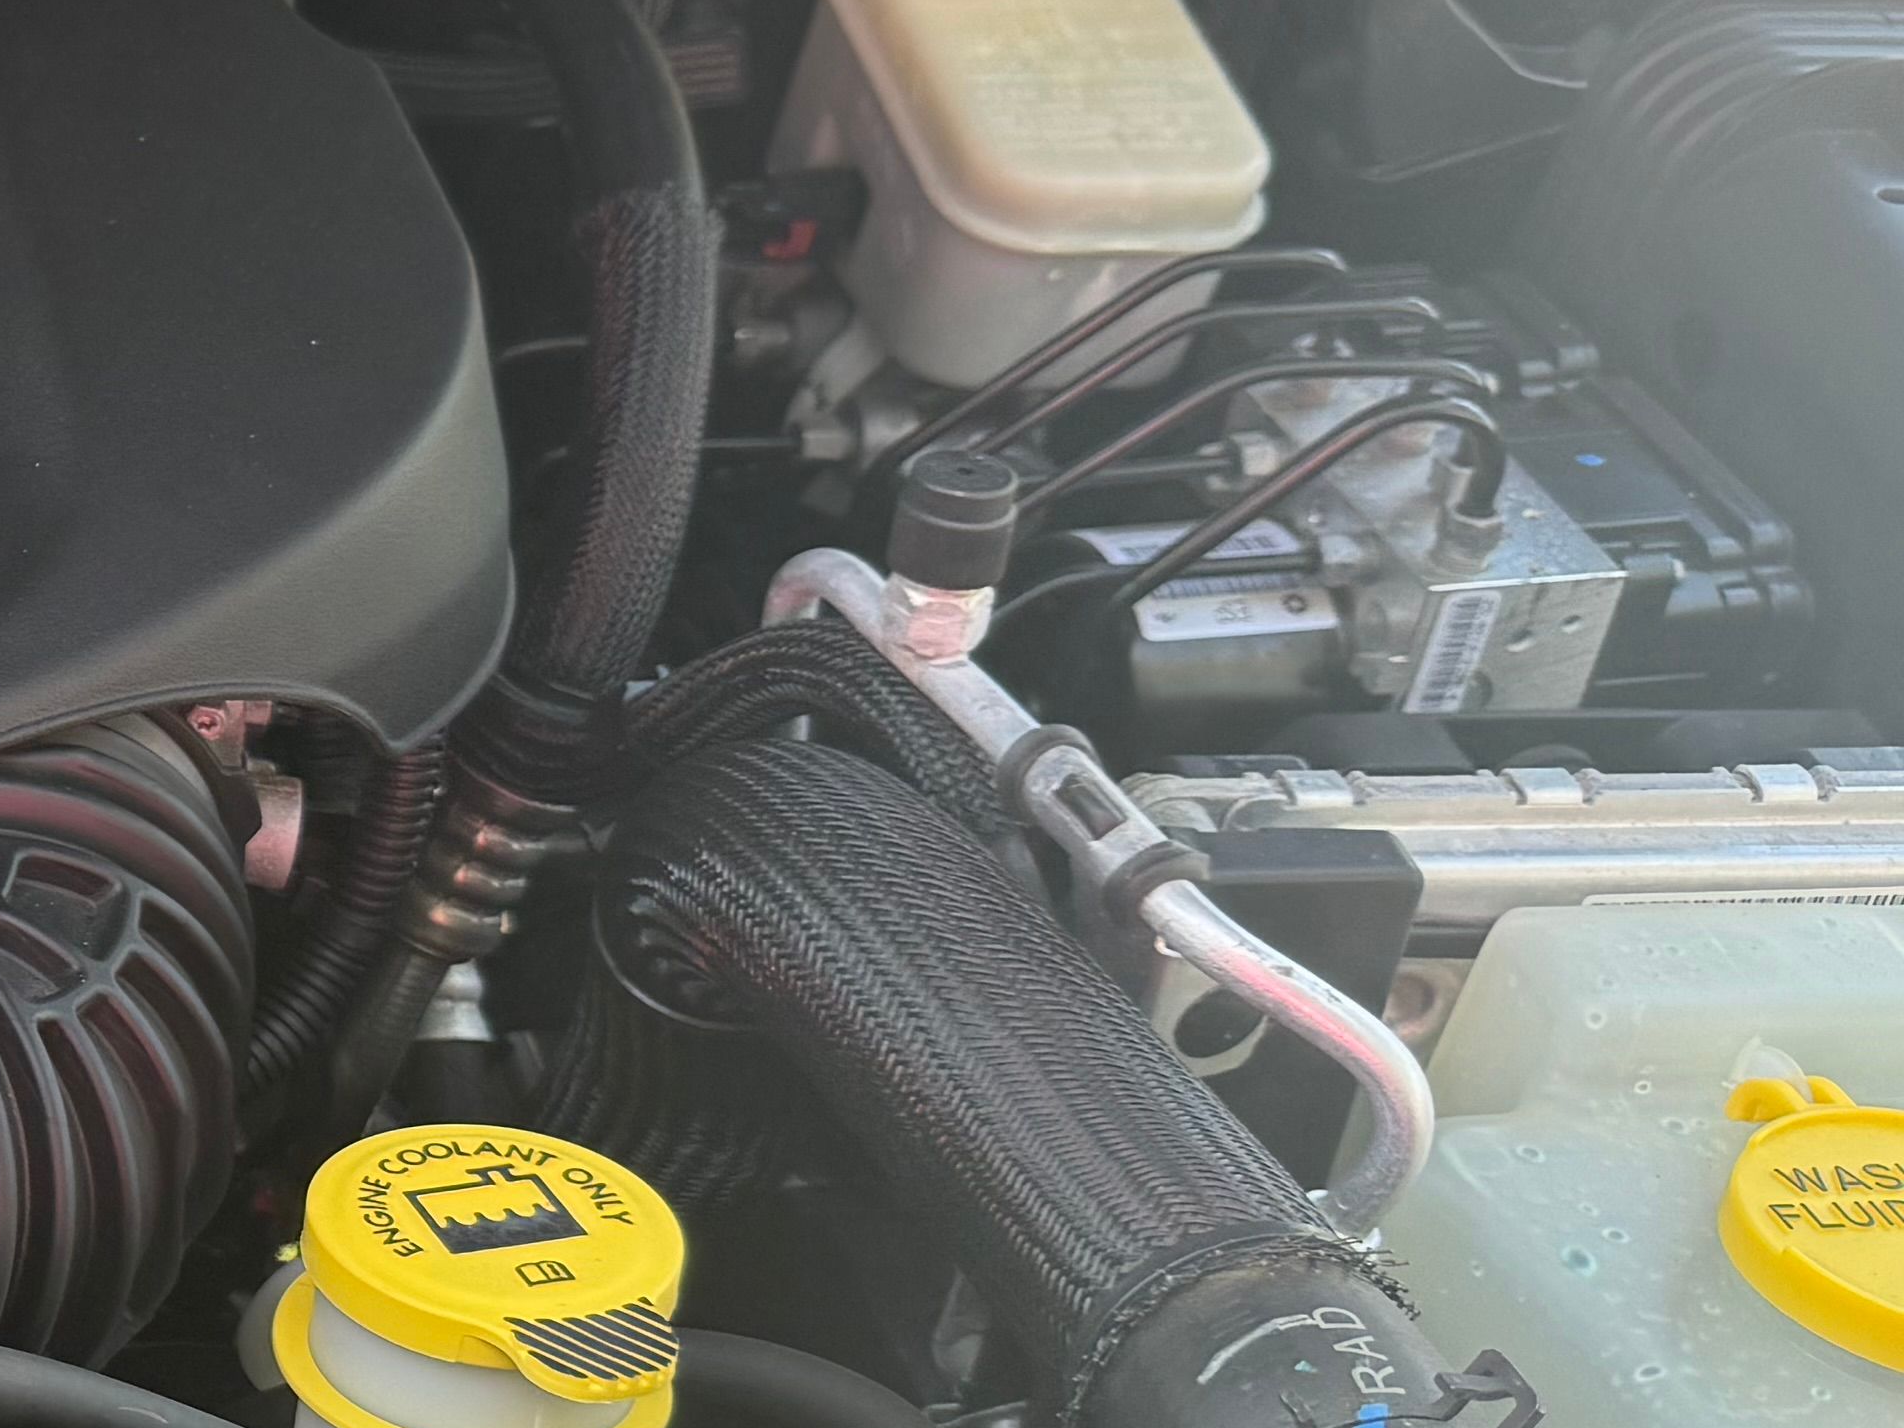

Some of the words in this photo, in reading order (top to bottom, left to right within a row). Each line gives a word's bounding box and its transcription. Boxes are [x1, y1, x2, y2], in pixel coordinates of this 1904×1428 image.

[377, 1140, 560, 1177] COOLANT
[1772, 1162, 1904, 1193] WAS
[357, 1175, 425, 1258] ENGINE
[561, 1167, 635, 1228] ONLY
[1312, 1306, 1406, 1395] RAD
